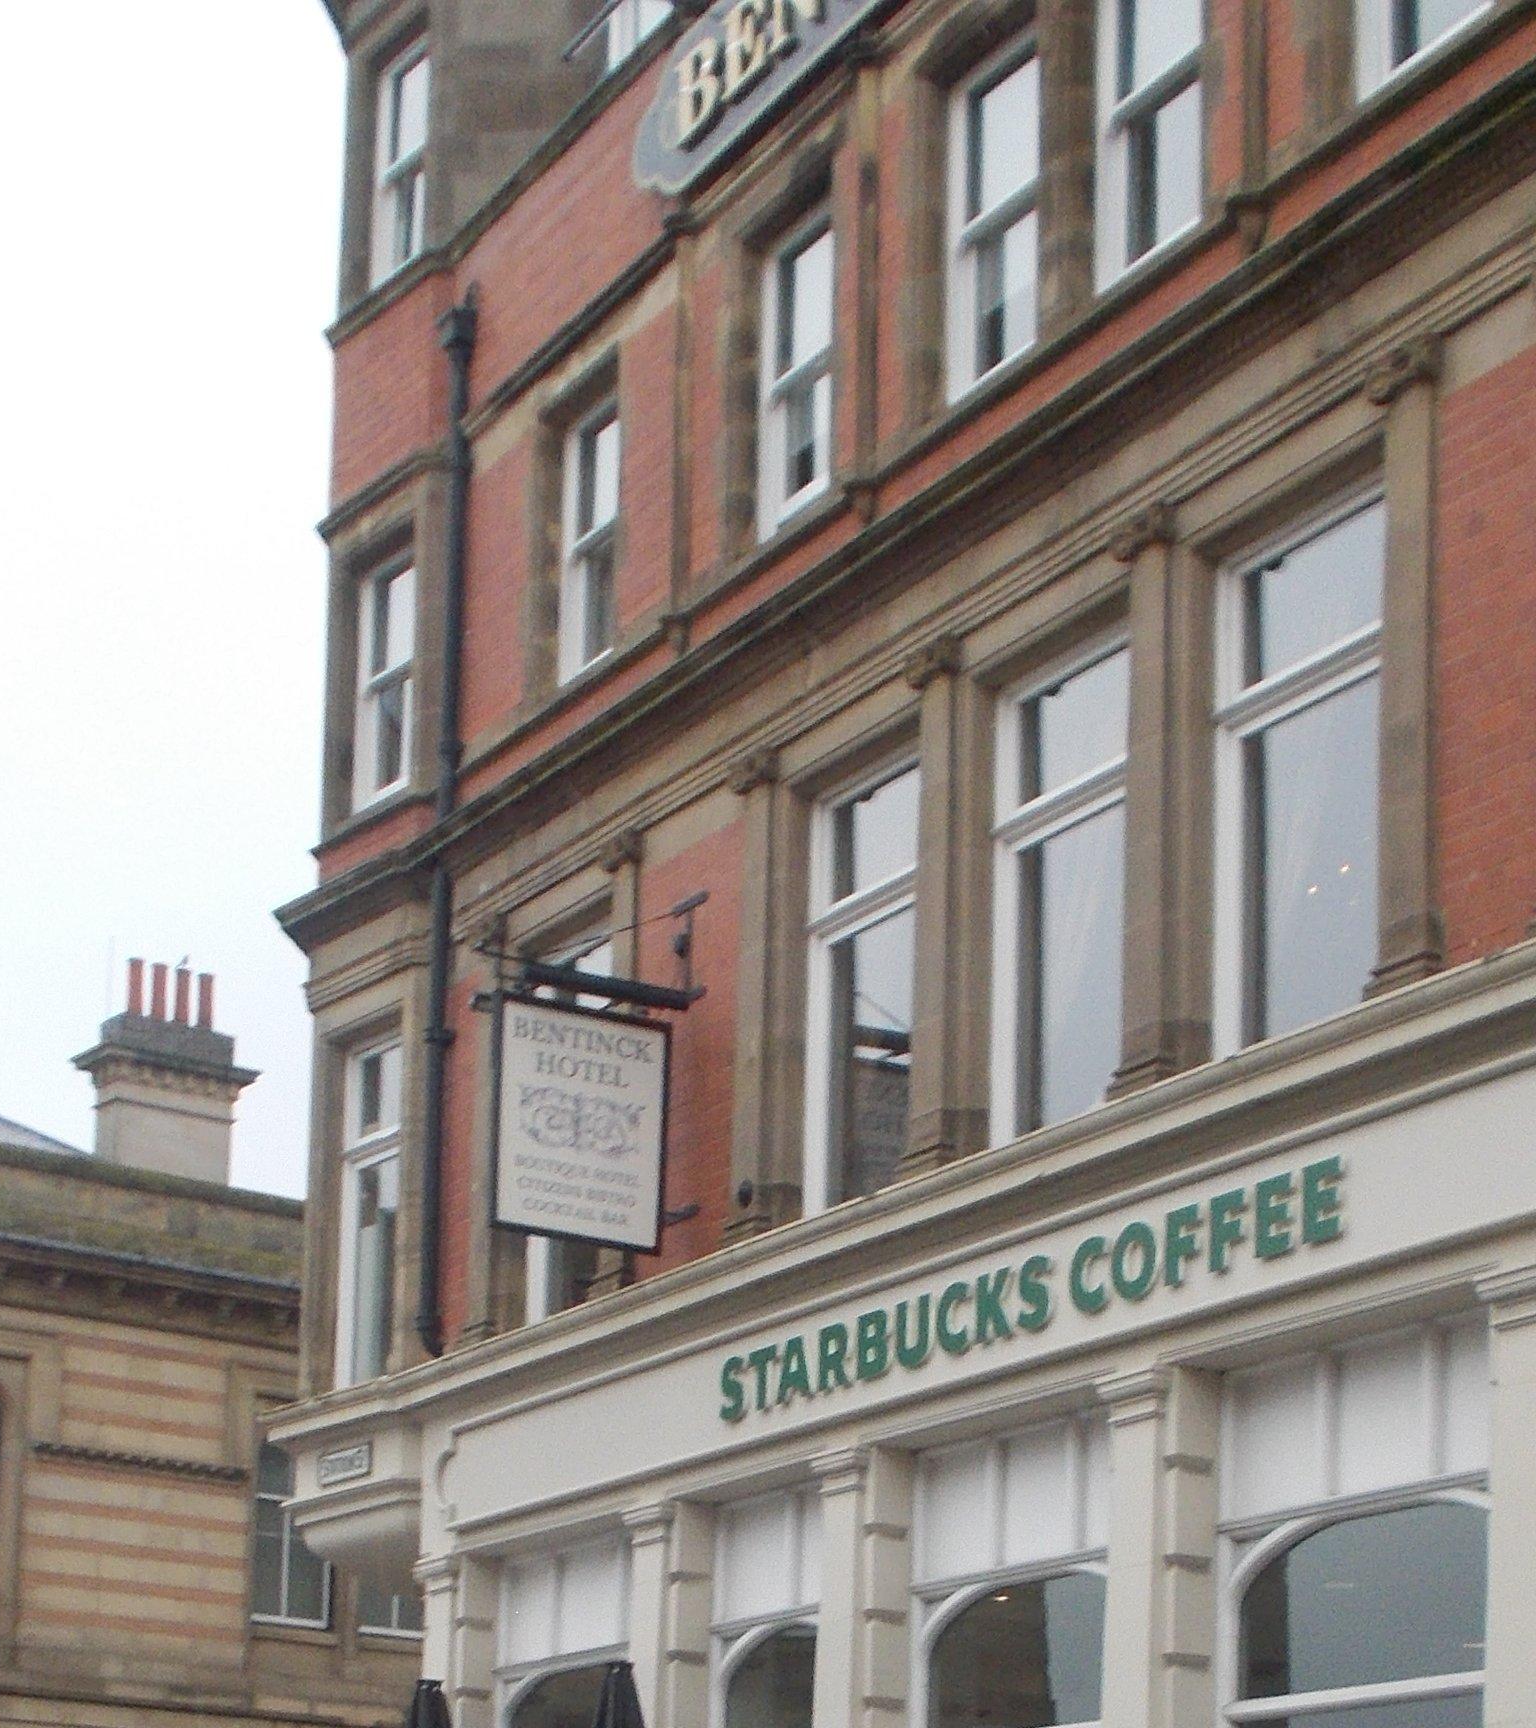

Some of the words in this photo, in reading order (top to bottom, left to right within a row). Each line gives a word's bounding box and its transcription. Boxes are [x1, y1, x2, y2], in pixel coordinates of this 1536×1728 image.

[512, 1015, 657, 1064] BENTINCK
[535, 1050, 631, 1089] HOTEL
[718, 1253, 1051, 1421] STARBUCKS
[1069, 1154, 1345, 1312] COFFEE
